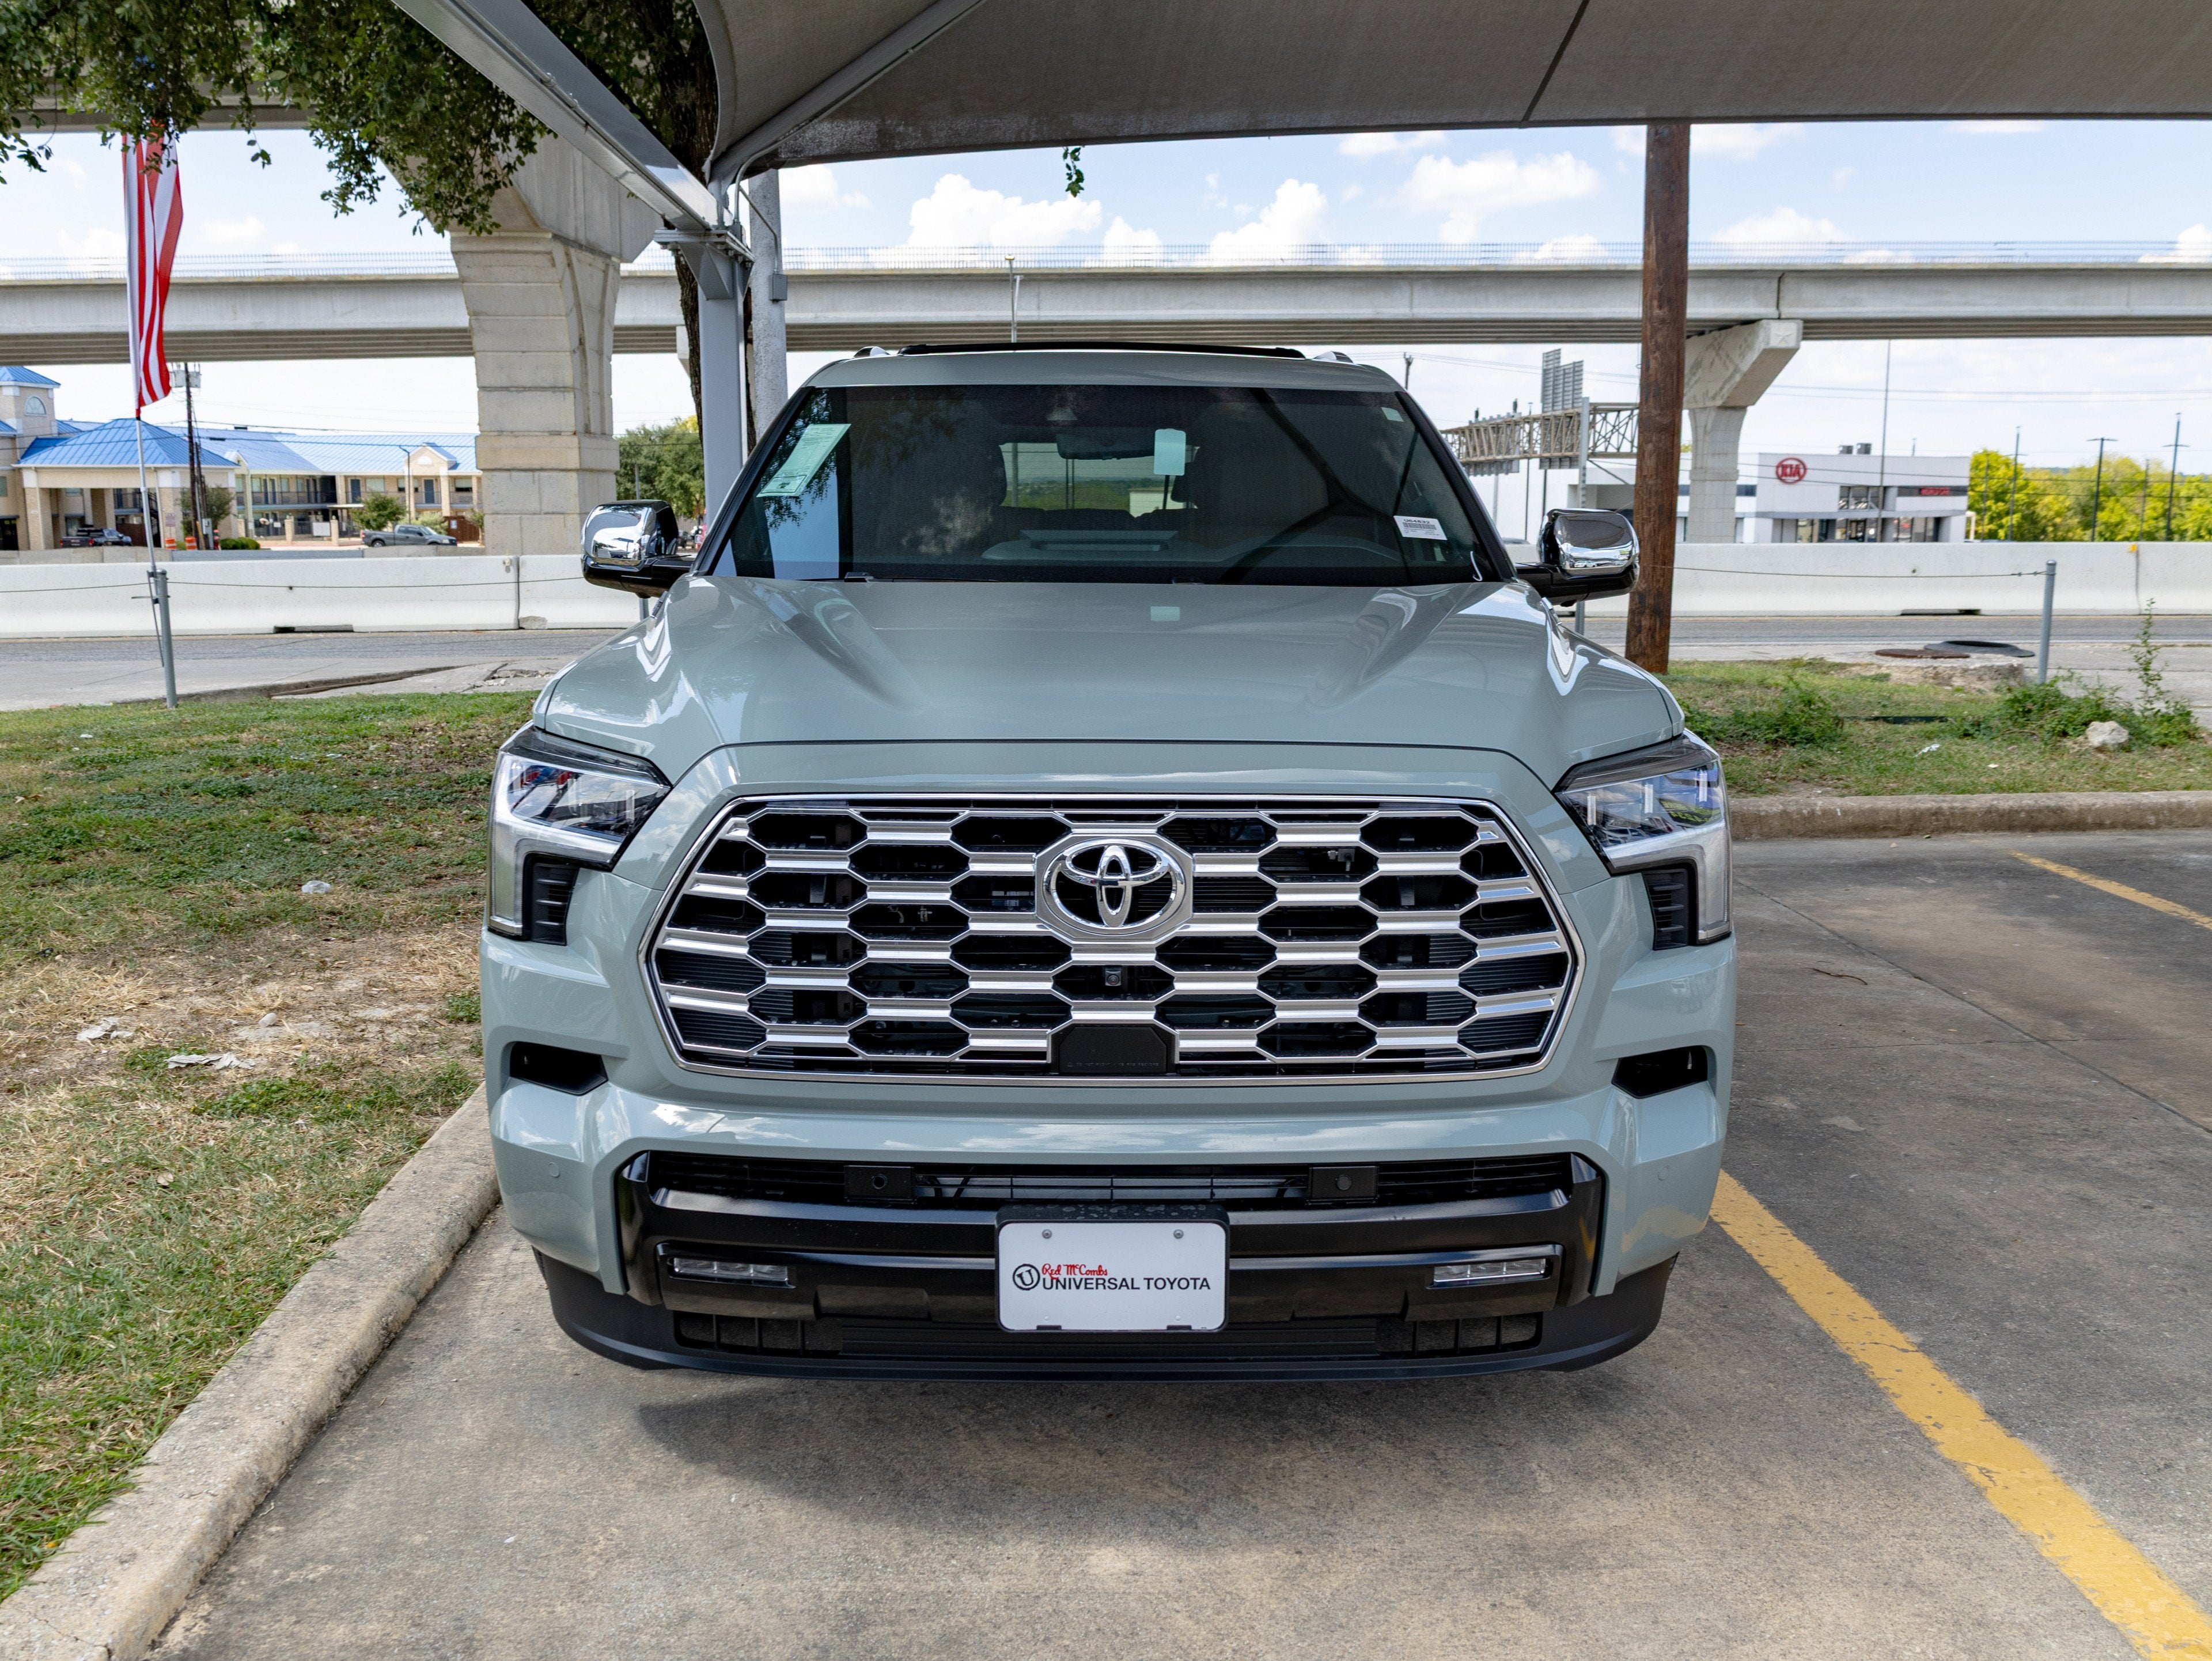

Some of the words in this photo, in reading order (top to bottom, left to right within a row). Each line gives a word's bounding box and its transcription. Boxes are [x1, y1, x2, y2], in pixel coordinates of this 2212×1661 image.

[1781, 464, 1801, 477] KIA
[1041, 1263, 1061, 1278] Red
[1043, 1277, 1141, 1290] UNIVERSAL
[1143, 1277, 1211, 1290] TOYOTA
